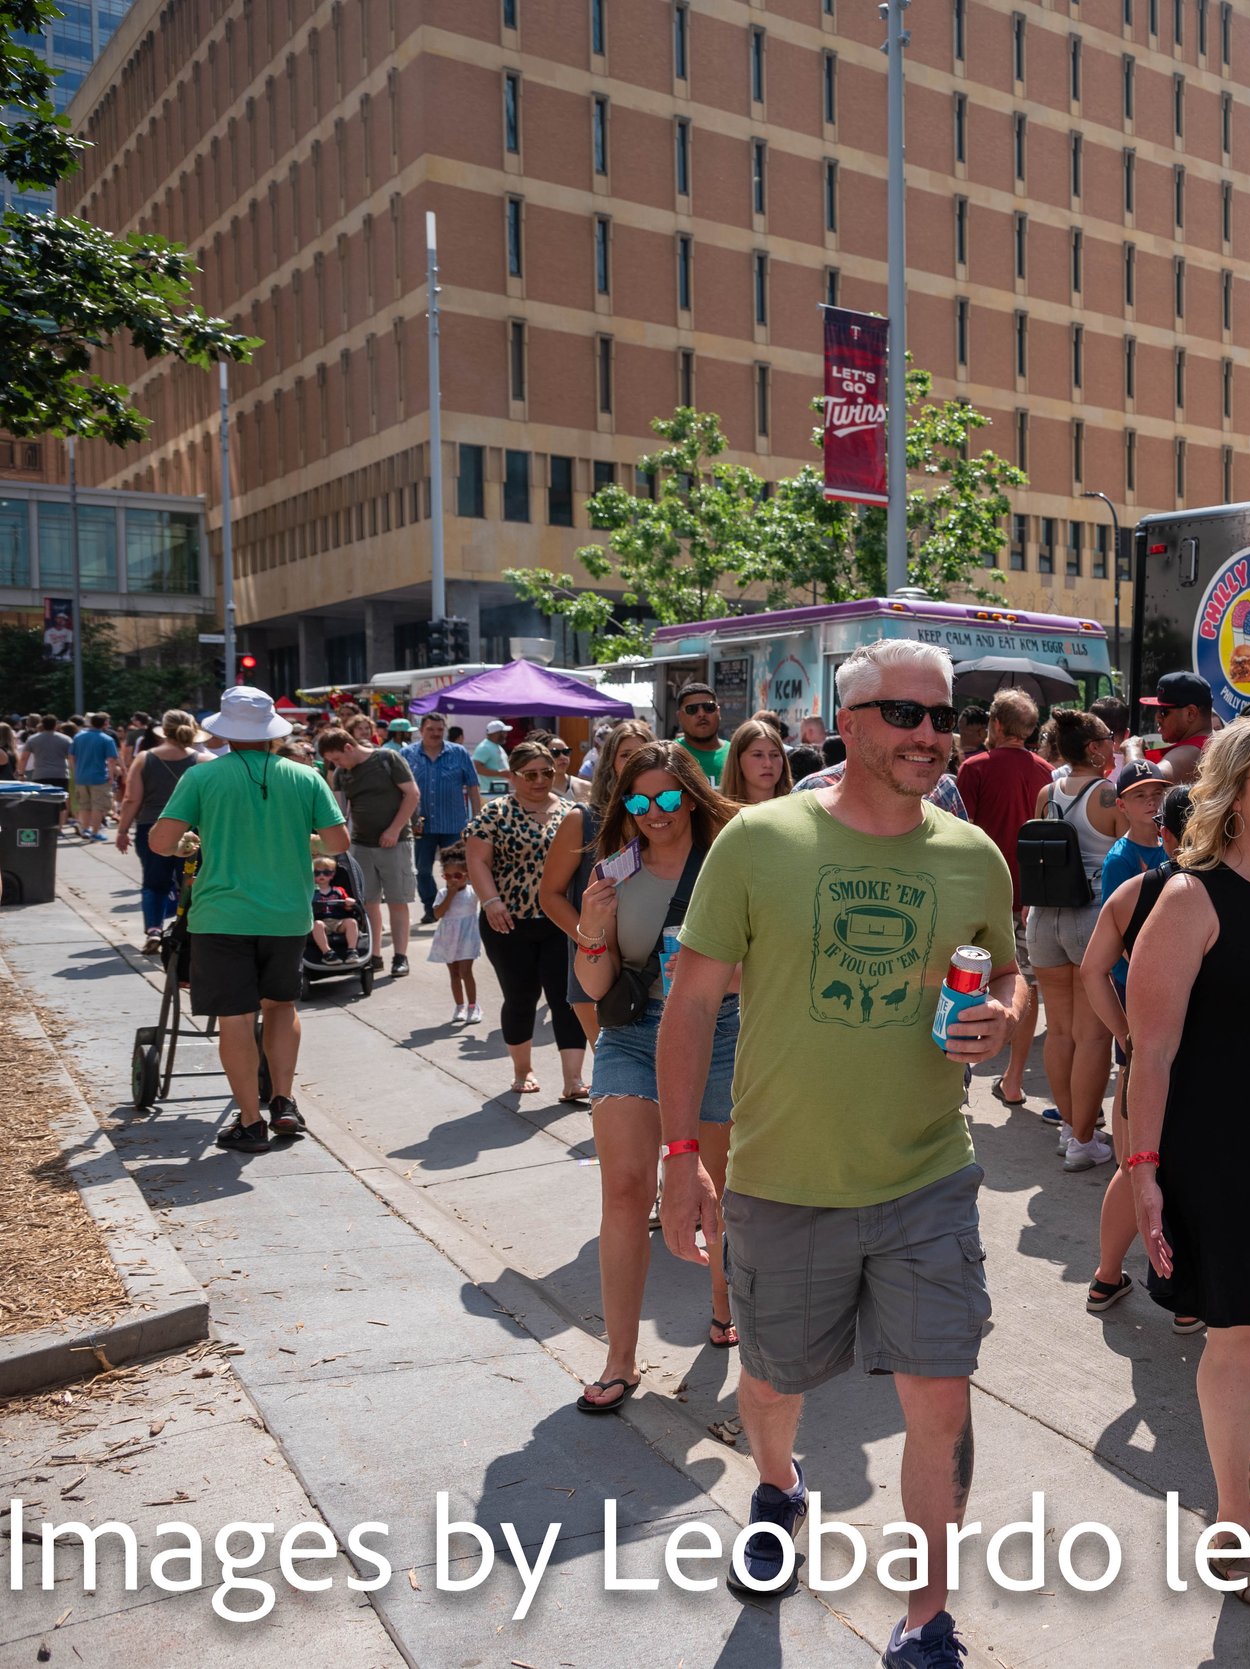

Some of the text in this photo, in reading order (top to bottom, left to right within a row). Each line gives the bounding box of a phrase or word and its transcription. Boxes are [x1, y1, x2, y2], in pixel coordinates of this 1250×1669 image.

[832, 365, 876, 384] LET'S
[842, 380, 866, 395] GO
[824, 396, 887, 438] Twins
[1200, 559, 1248, 641] PHILLY
[917, 628, 941, 643] KEEP
[945, 631, 972, 646] CALM
[975, 634, 995, 648] AND
[998, 636, 1016, 650] EAT
[1020, 637, 1039, 652] KCM
[775, 679, 803, 701] KCM
[1220, 685, 1241, 710] PHILLY
[1133, 761, 1153, 777] M
[828, 880, 927, 909] SMOKE 'EM
[824, 942, 921, 977] IF YOU GOT 'EM
